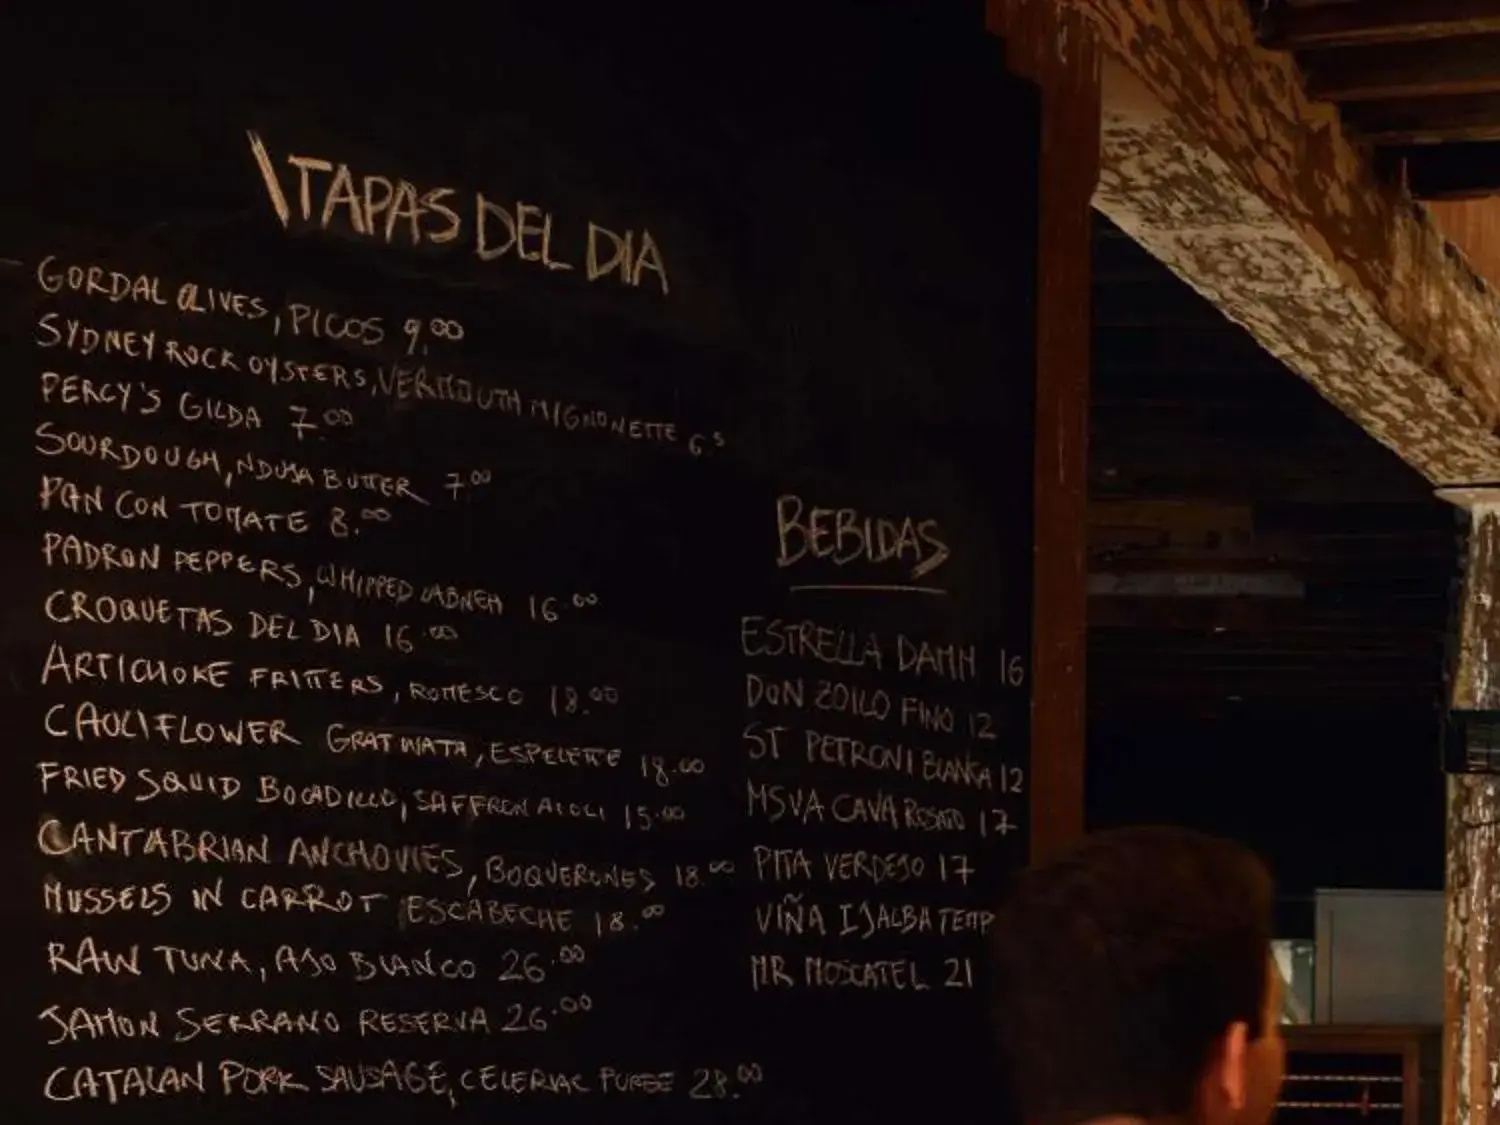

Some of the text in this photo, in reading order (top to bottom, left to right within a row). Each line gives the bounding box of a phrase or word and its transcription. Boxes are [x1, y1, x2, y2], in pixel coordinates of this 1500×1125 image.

[474, 193, 575, 270] DEL
[586, 221, 669, 296] DIA
[36, 255, 168, 304] GORDAL
[34, 312, 156, 360] SYDNEY
[165, 340, 241, 370] ROCK
[40, 371, 162, 415] PERCY'S
[178, 391, 263, 429] GILDA
[38, 474, 104, 514] PAN
[114, 490, 169, 520] CON
[179, 501, 310, 534] TOMATE
[323, 467, 430, 506] BUTTER
[40, 531, 160, 571] PADRON
[775, 493, 951, 580] BEBIDAS
[43, 590, 234, 637] CROQUETAS
[248, 609, 301, 641] DEL
[309, 617, 361, 649] DIA
[40, 639, 234, 688] ARTICHOKE
[741, 615, 882, 671] ESTRELLA
[1000, 648, 1025, 687] 16
[43, 700, 302, 746] CAULIFLOWER
[746, 673, 804, 709] DON
[901, 697, 955, 733] FINO
[968, 712, 997, 739] 12
[36, 761, 127, 795] FRIED
[134, 766, 242, 802] SQUID
[742, 721, 791, 760] ST
[805, 729, 914, 776] PETRONI
[1000, 762, 1025, 795] 12
[831, 788, 899, 830] CAVA
[979, 807, 1018, 838] 17
[37, 817, 271, 863] CANTABRIAN
[823, 850, 925, 886] VERDEJO
[939, 852, 976, 886] 17
[43, 880, 173, 917] MUSSELS
[191, 876, 225, 912] IN
[240, 883, 388, 914] CARROT
[405, 894, 575, 933] ESCABECHE
[756, 892, 826, 936] VIÑA
[47, 935, 143, 977] RAW
[274, 944, 339, 979] AJO
[944, 957, 975, 989] 21
[37, 1003, 161, 1046] JAMON
[173, 1006, 341, 1043] SERRANO
[358, 1005, 492, 1037] RESERVA
[42, 1060, 206, 1106] CATALAN
[218, 1058, 310, 1097] PORK
